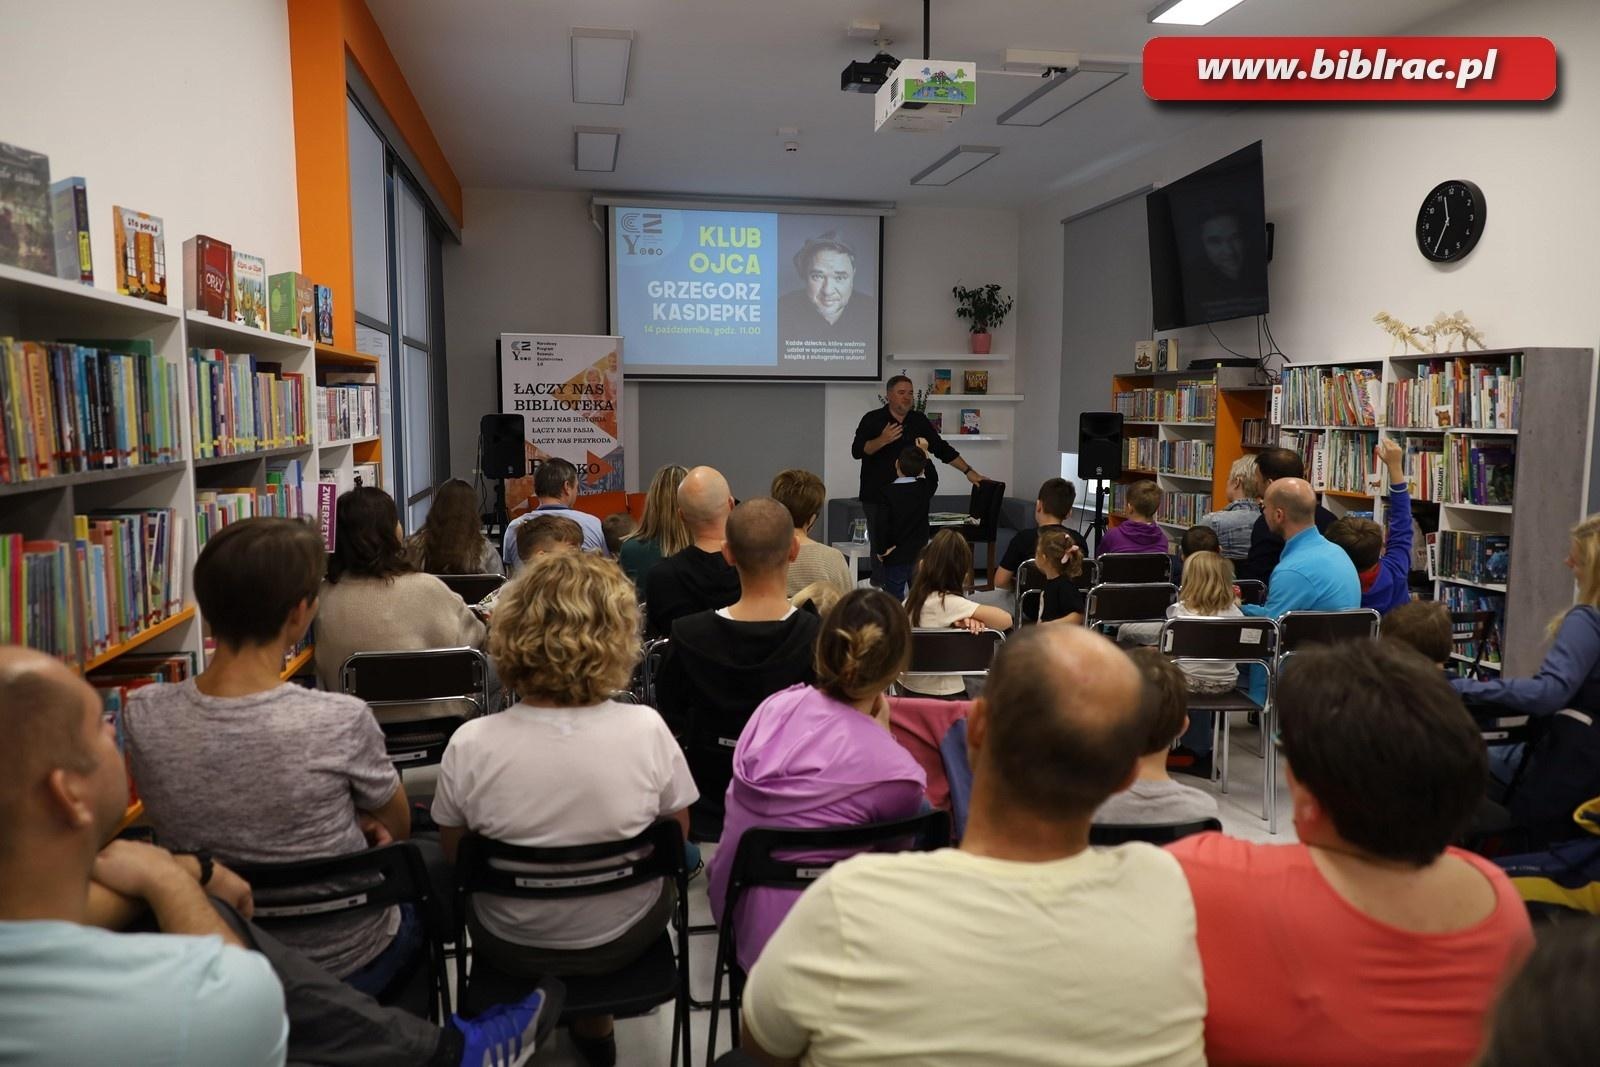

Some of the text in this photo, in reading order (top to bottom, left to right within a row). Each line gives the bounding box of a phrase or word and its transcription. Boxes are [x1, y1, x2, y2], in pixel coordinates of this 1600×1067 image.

[699, 225, 762, 248] KLUB
[688, 252, 762, 275] OJCA
[648, 280, 761, 300] GRZEGORZ
[653, 302, 761, 322] KASDEPKE
[644, 325, 654, 334] 14
[739, 326, 761, 334] 11.00
[514, 383, 604, 397] ŁĄCZY NAS
[514, 400, 614, 411] BIBLIOTEKA
